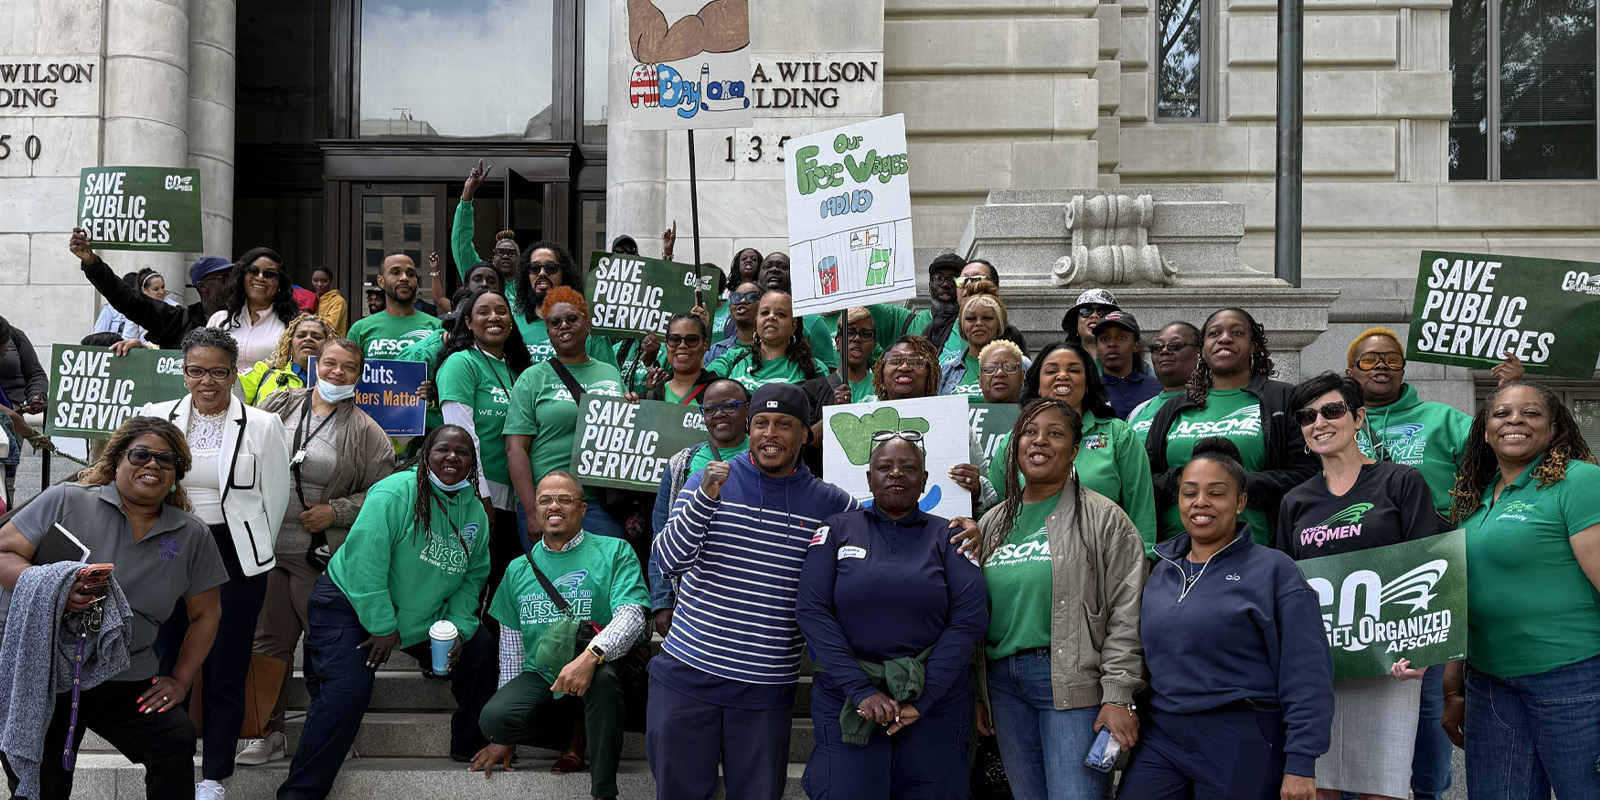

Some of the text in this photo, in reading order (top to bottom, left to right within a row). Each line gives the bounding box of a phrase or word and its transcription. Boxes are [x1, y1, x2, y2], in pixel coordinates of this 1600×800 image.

[0, 63, 94, 83] WILSON
[776, 61, 878, 83] WILSON
[833, 133, 863, 154] Our
[84, 172, 126, 195] SAVE
[81, 195, 147, 219] PUBLIC
[81, 218, 170, 243] SERVICES
[595, 256, 646, 283] SAVE
[1427, 258, 1502, 293] SAVE
[592, 279, 664, 308] PUBLIC
[591, 303, 675, 334] SERVICE
[1421, 290, 1527, 328] PUBLIC
[1417, 321, 1555, 363] SERVICES
[59, 350, 114, 377] SAVE
[362, 363, 398, 385] Cuts.
[56, 376, 135, 405] PUBLIC
[355, 389, 421, 407] kers Matter
[585, 400, 640, 428] SAVE
[1171, 418, 1262, 434] AFSCME
[580, 425, 659, 455] PUBLIC
[577, 450, 668, 483] SERVICE
[1300, 523, 1362, 547] WOMEN
[1358, 609, 1452, 644] ORGANIZED
[1384, 629, 1450, 654] AFSCME
